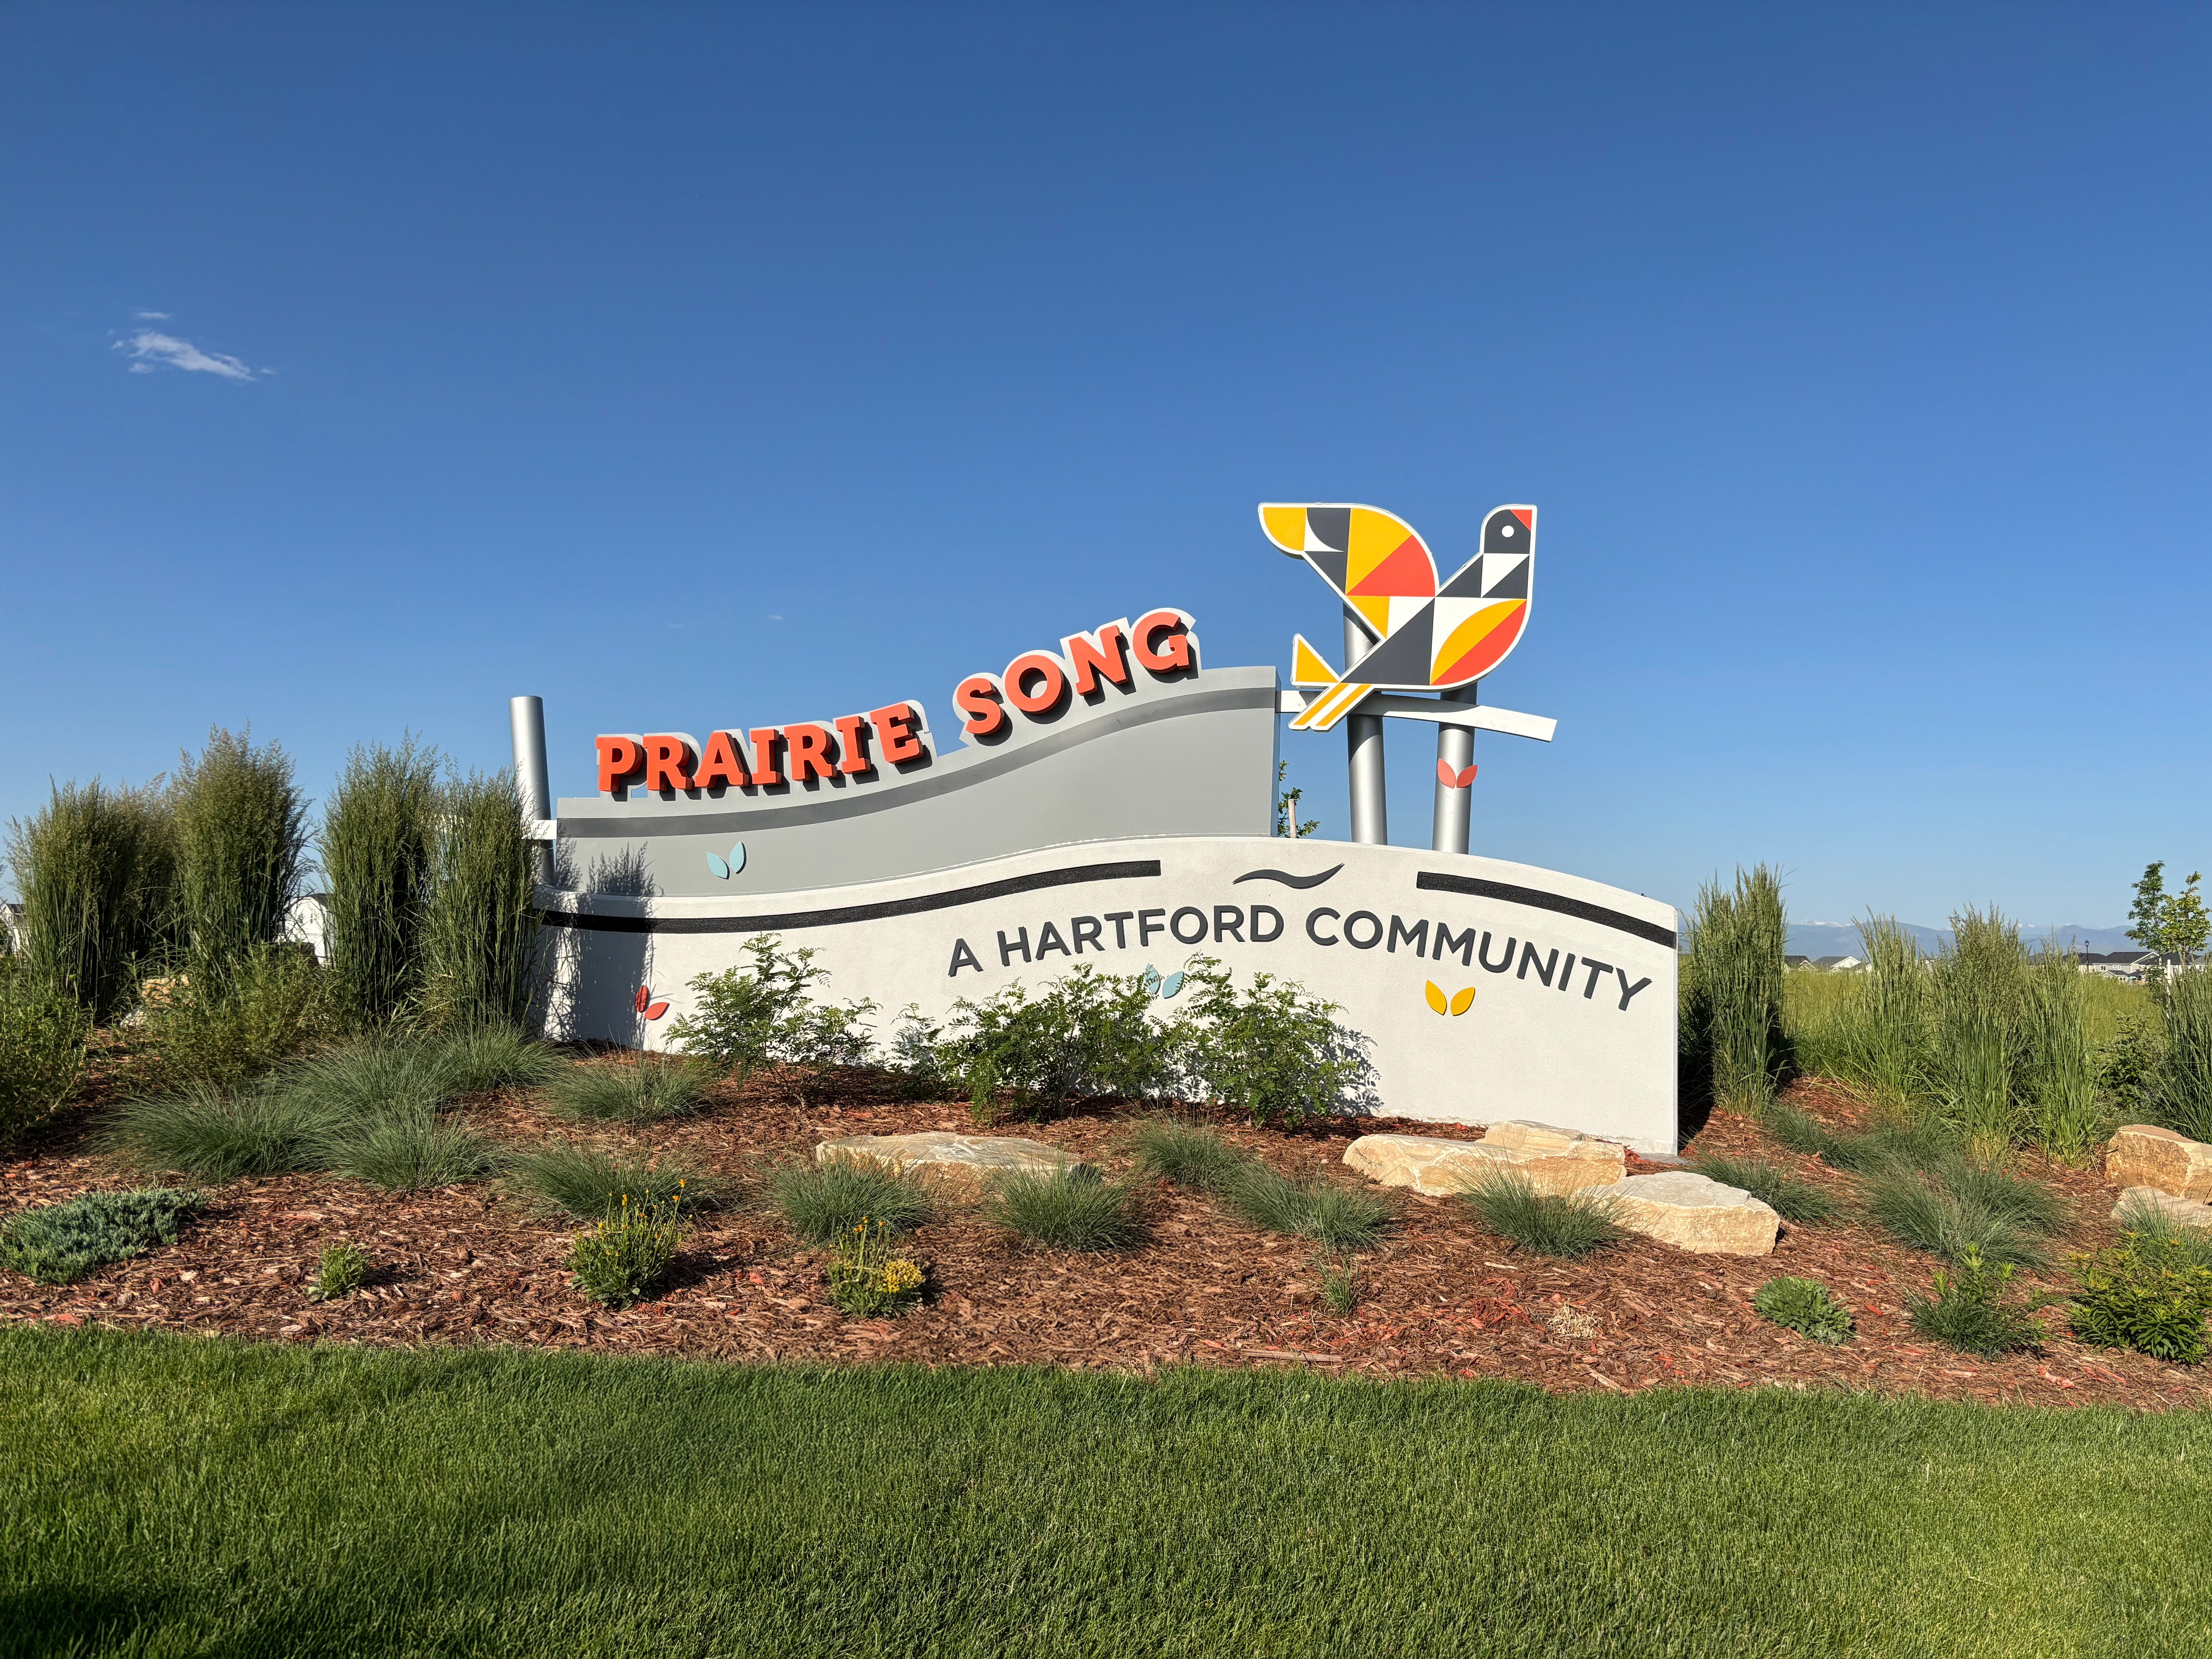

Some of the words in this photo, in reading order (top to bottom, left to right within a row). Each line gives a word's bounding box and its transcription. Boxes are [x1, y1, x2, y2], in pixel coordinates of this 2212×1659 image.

[596, 703, 924, 792] PRAIRIE
[957, 612, 1190, 736] SONG
[948, 938, 984, 978] A
[996, 904, 1285, 967] HARTFORD
[1305, 907, 1653, 1012] COMMUNITY
